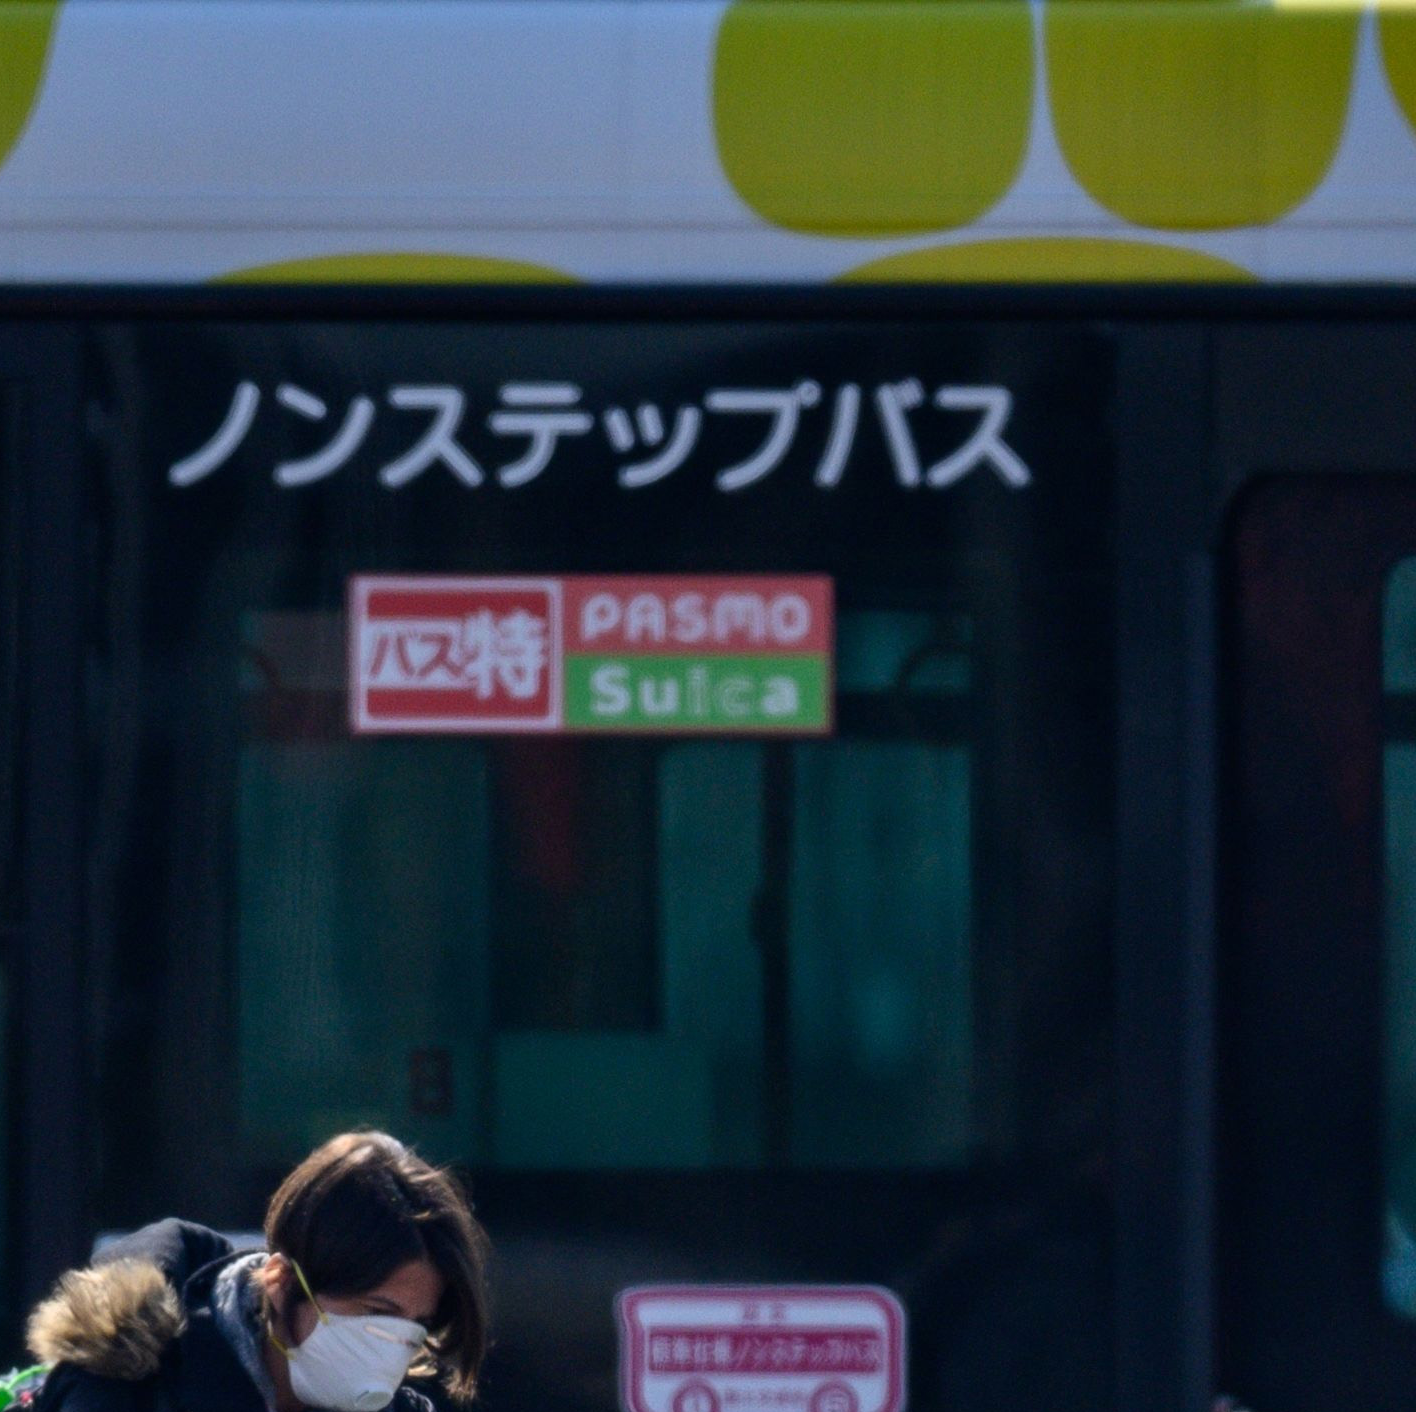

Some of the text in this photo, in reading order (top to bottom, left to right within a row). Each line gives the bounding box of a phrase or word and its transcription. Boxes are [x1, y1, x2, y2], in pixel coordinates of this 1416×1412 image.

[169, 379, 1031, 490] ノンステップバス
[581, 592, 812, 644] PASMO
[368, 609, 548, 700] バス特
[588, 663, 799, 717] Suica
